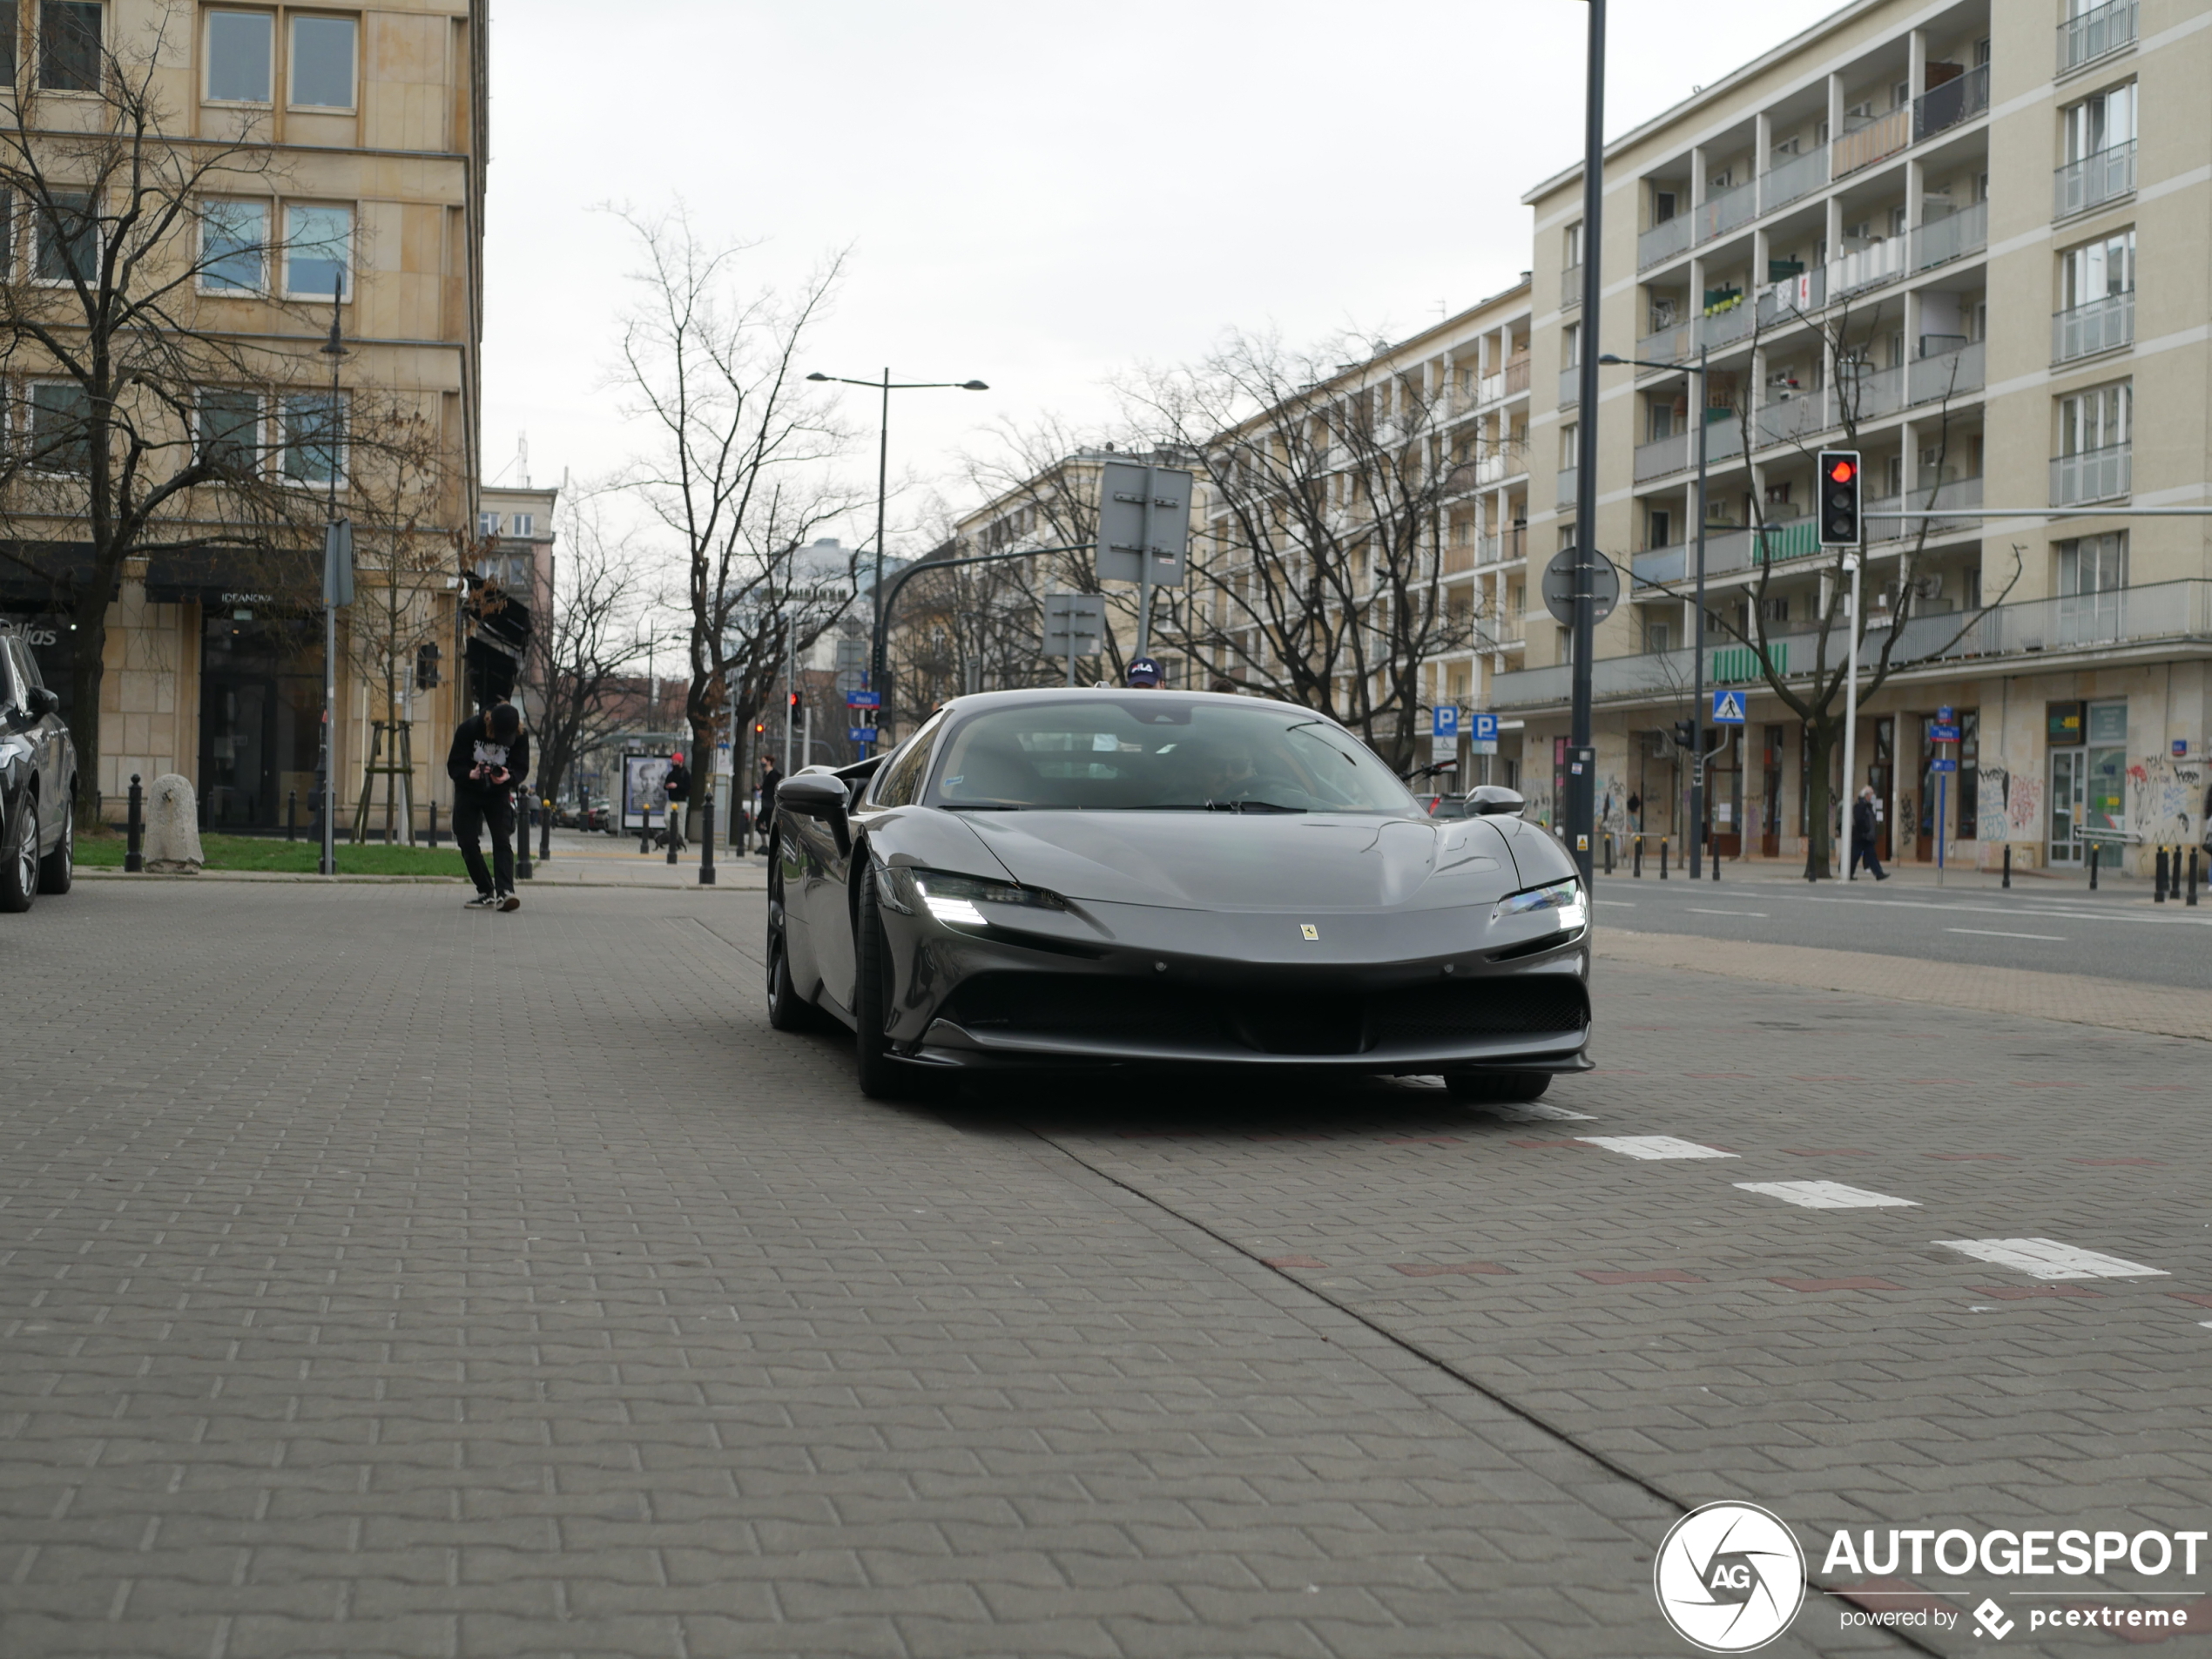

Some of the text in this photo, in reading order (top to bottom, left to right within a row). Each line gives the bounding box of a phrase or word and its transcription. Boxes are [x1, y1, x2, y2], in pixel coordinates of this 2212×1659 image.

[1132, 663, 1153, 673] FILA
[1439, 709, 1453, 729] P
[1478, 717, 1493, 738] P
